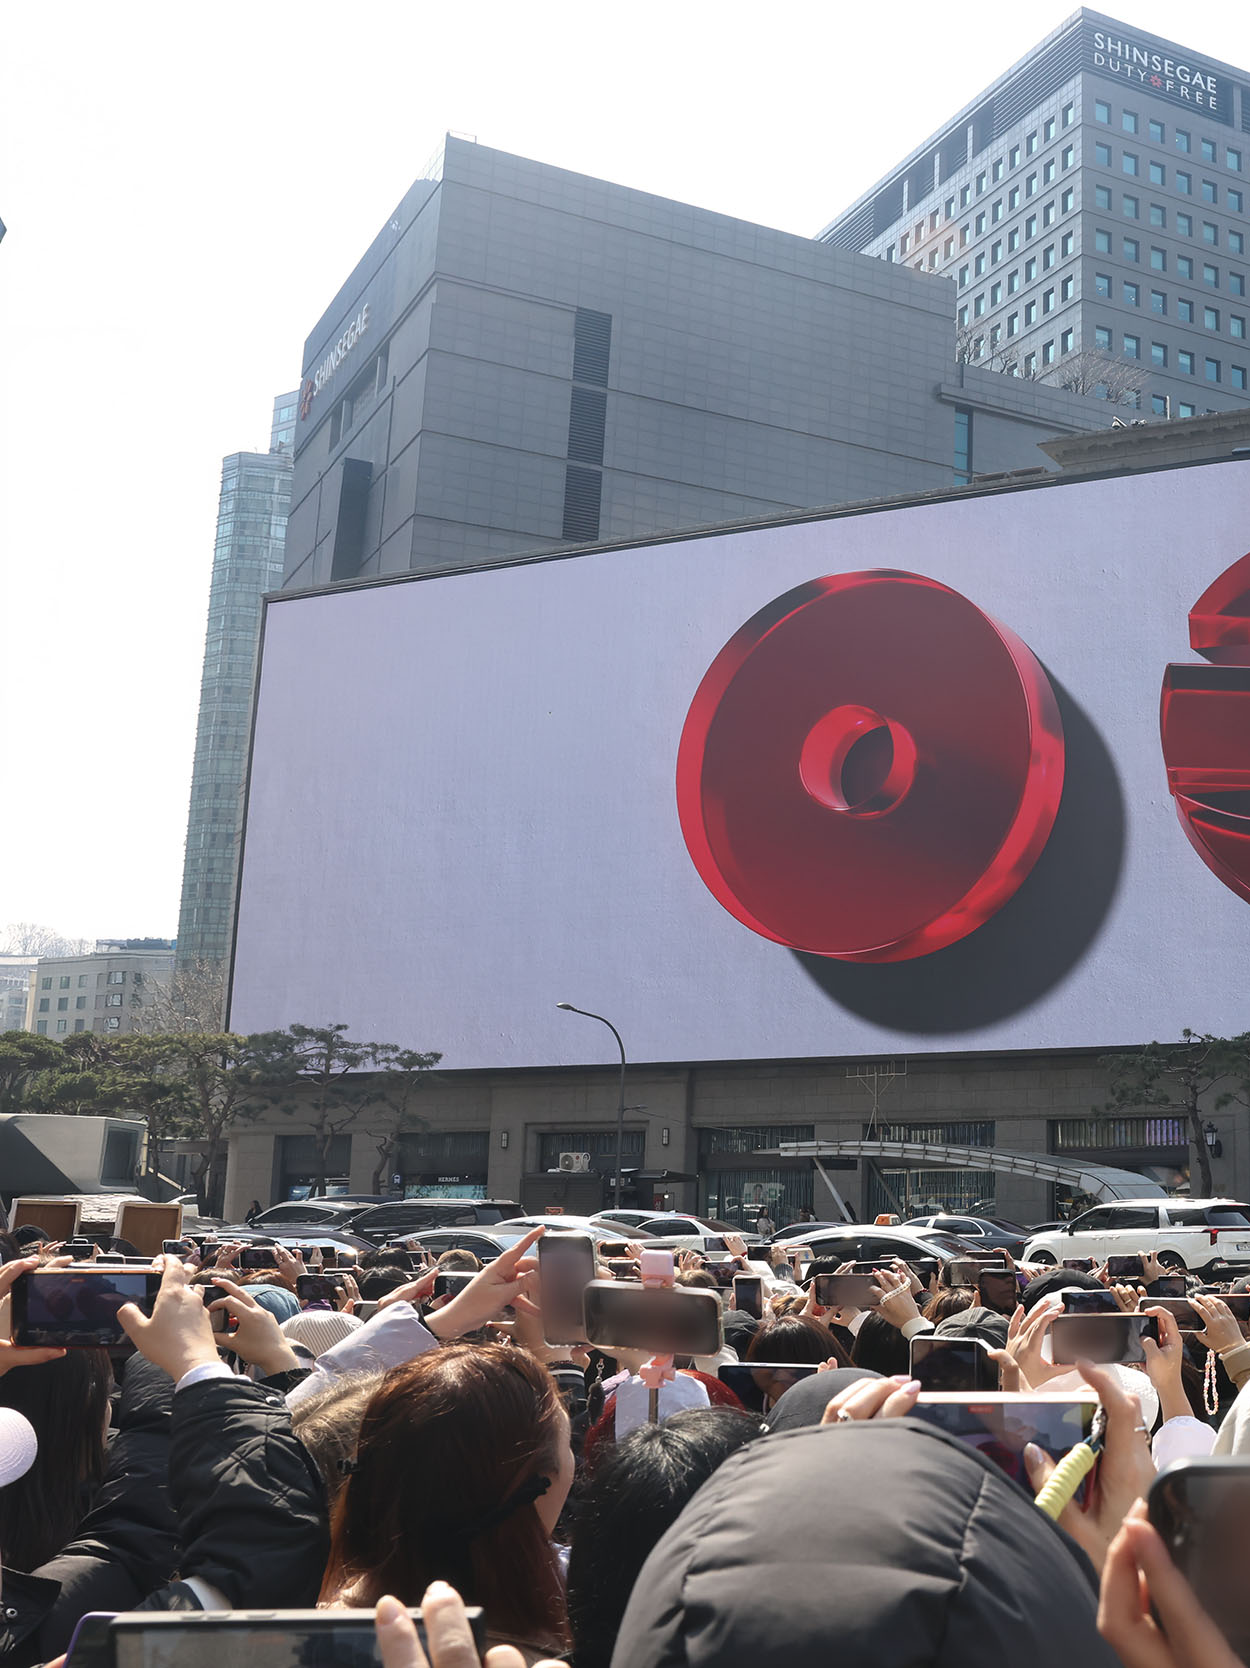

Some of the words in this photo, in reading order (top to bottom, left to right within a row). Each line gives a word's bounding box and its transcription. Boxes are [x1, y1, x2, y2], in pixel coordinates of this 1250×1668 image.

[1094, 32, 1217, 94] SHINSEGAE
[1094, 52, 1147, 82] DUTY
[1166, 79, 1217, 110] FREE
[313, 302, 369, 396] SHINSEGAE
